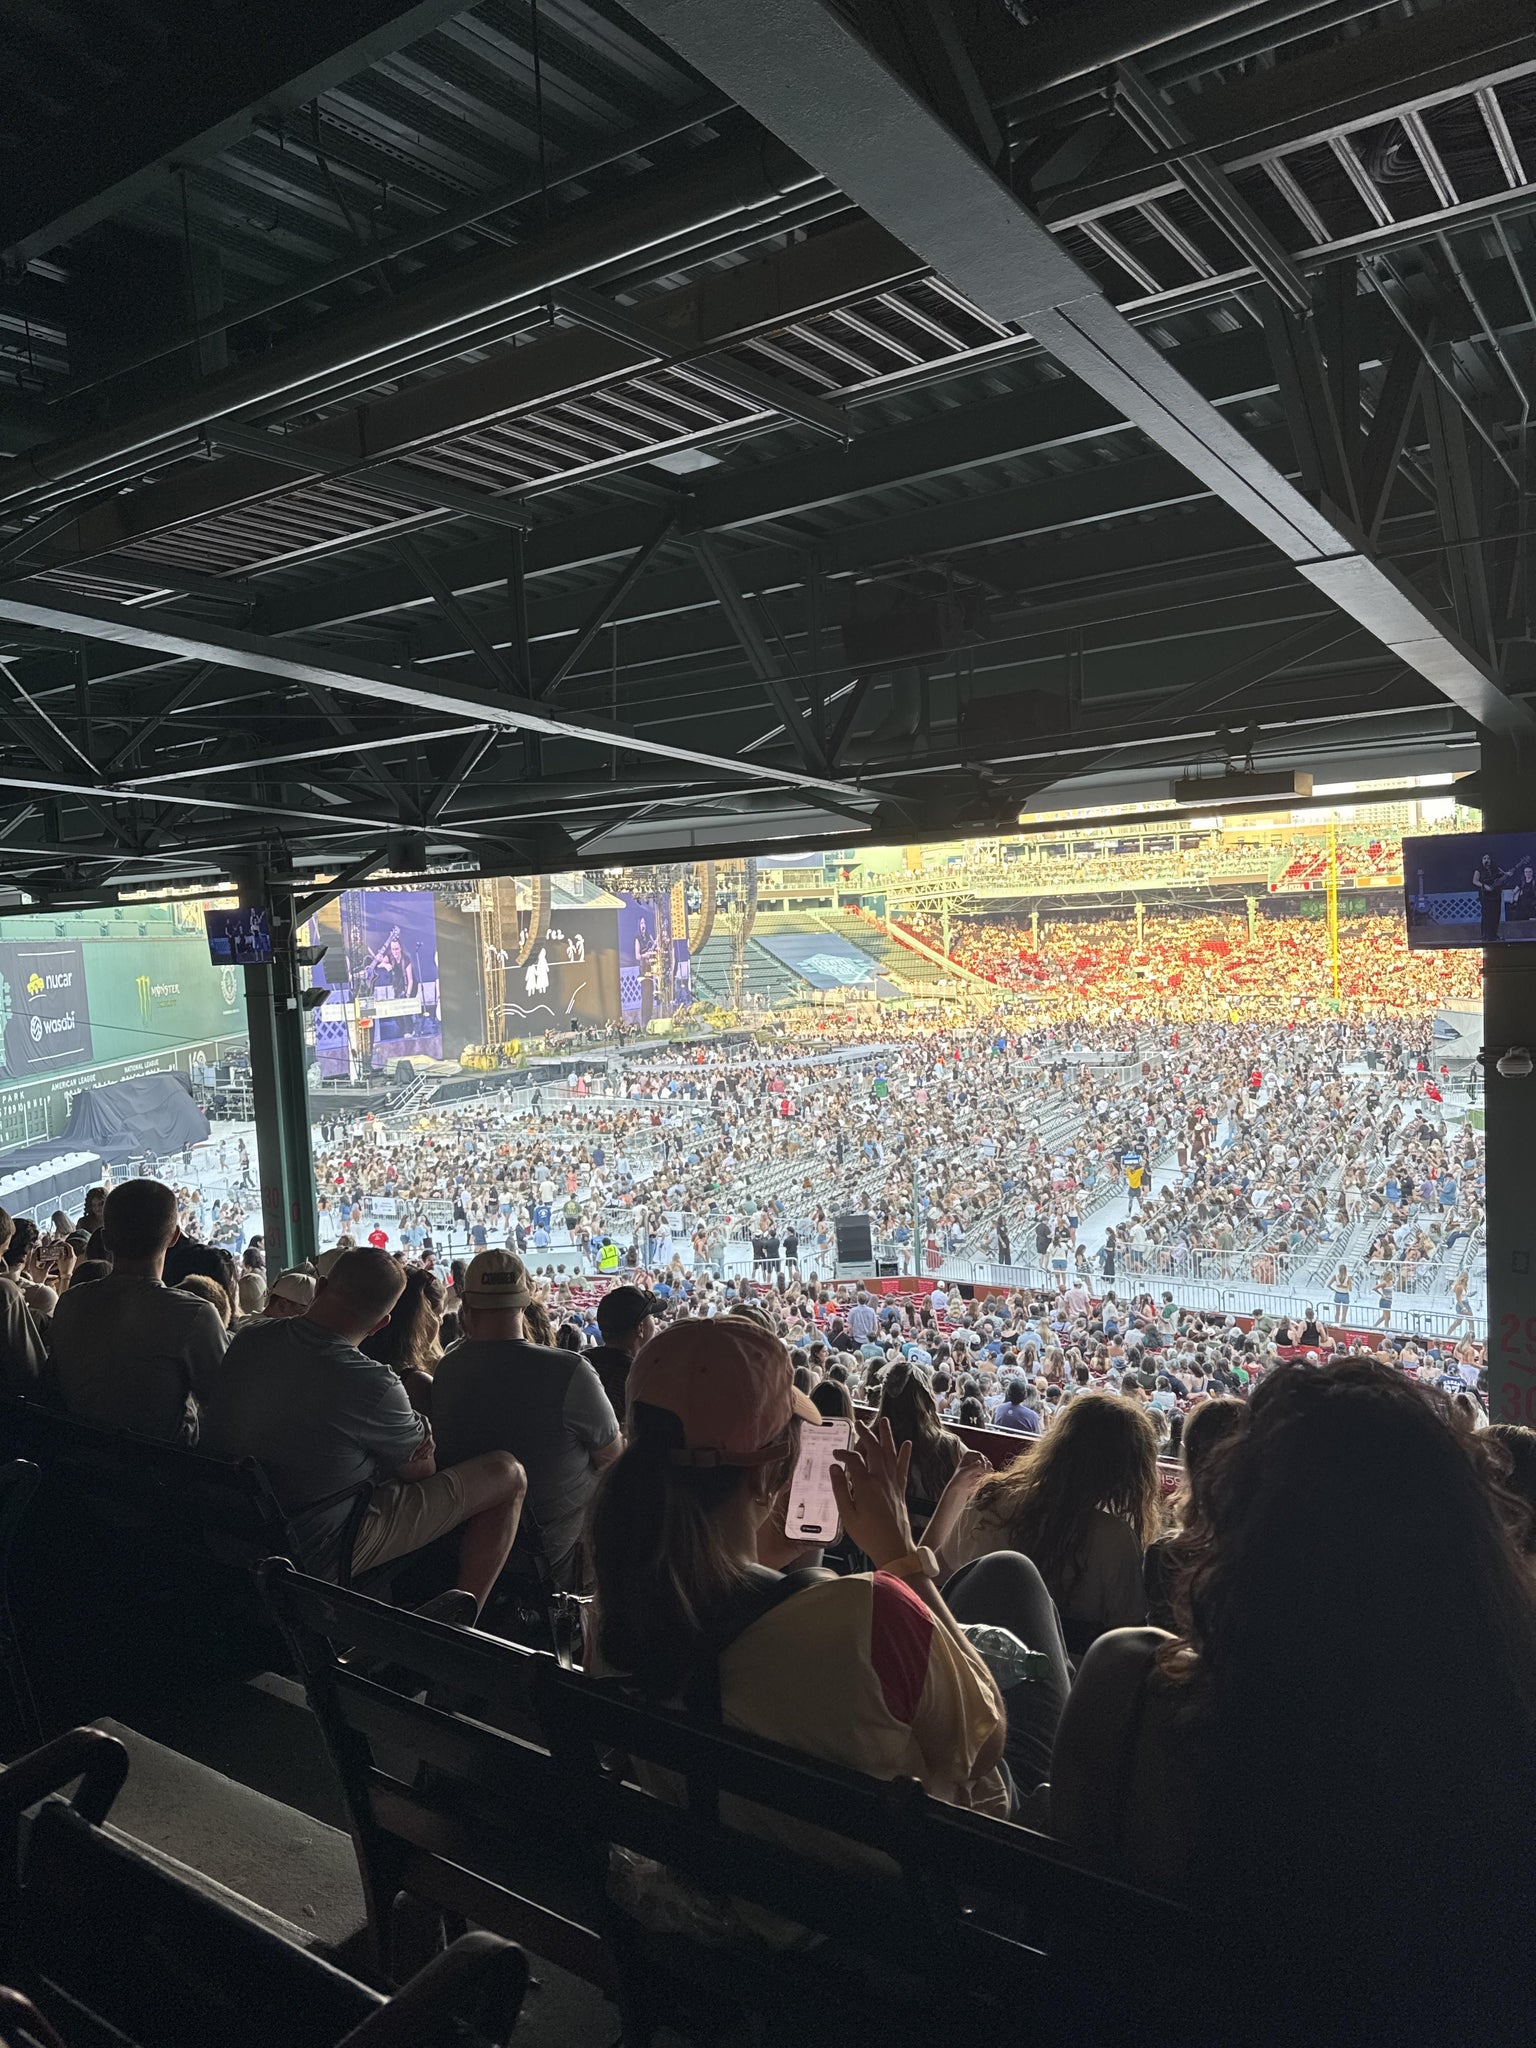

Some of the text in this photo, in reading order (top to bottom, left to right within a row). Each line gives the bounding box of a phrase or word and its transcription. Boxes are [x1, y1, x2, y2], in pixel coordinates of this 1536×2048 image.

[45, 972, 73, 990] nucar
[151, 983, 181, 998] MONSTER
[43, 1010, 76, 1034] wasabi
[124, 1063, 144, 1074] NATIONAL
[144, 1058, 160, 1069] LEAGUE
[51, 1078, 77, 1092] AMERICAN
[78, 1073, 97, 1085] LEAGUE
[2, 1091, 25, 1104] PARK
[264, 1186, 280, 1208] 30
